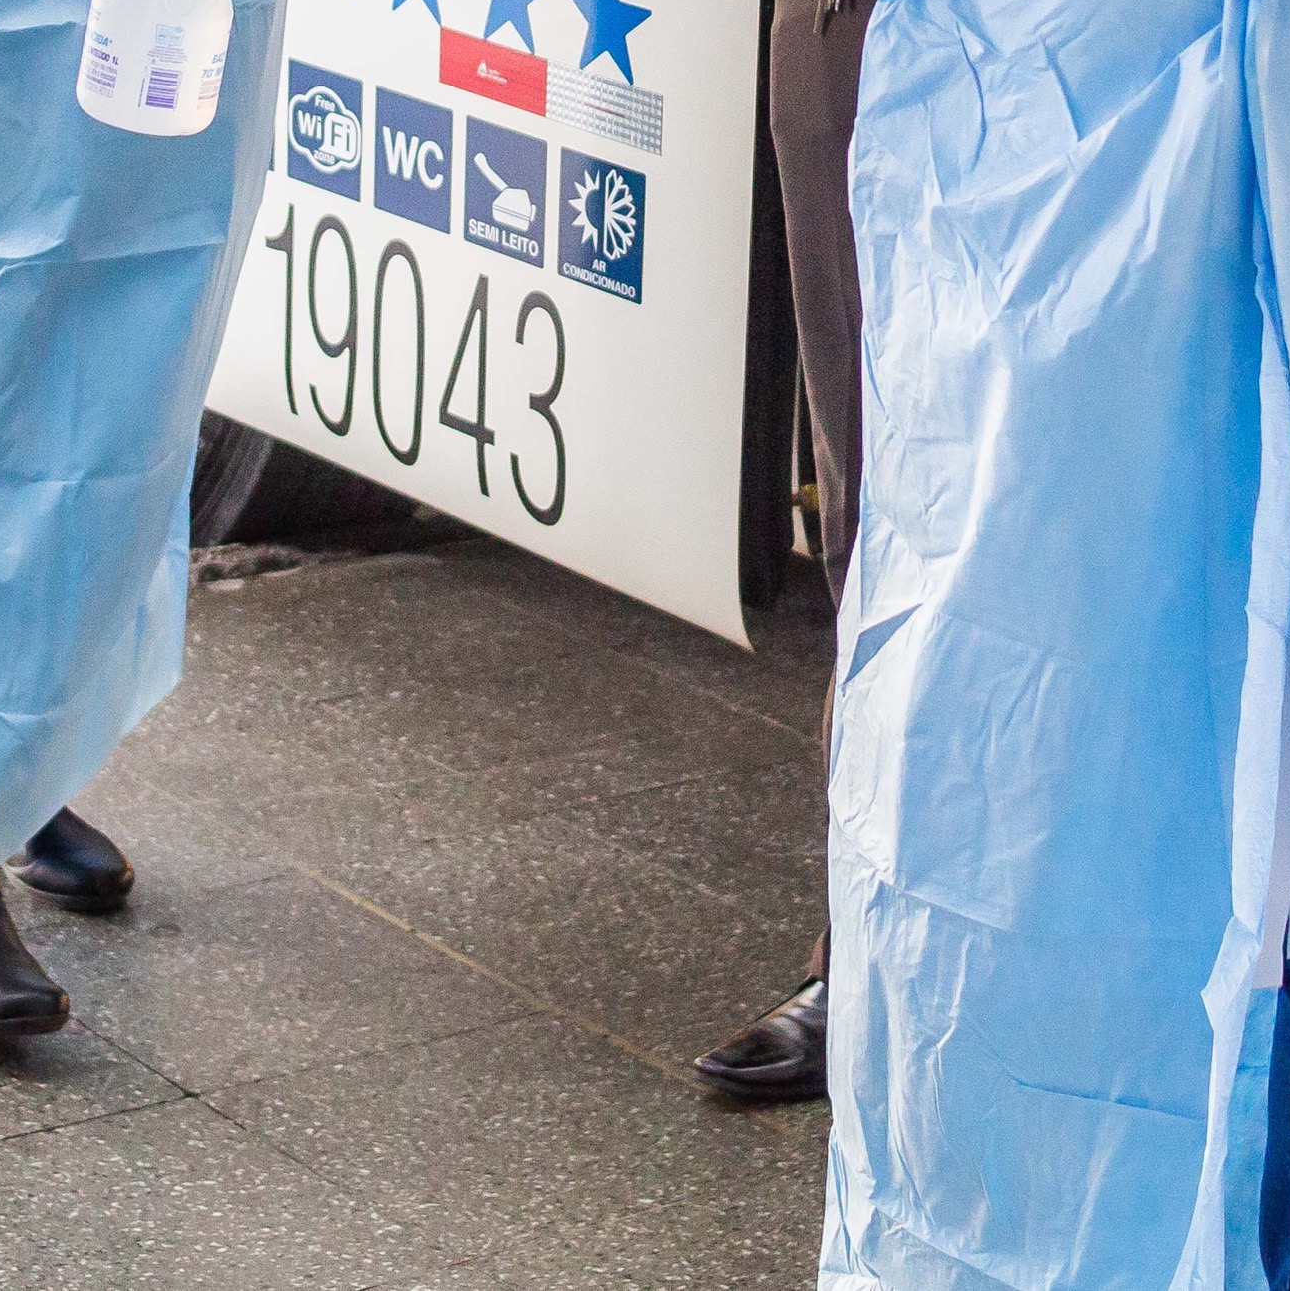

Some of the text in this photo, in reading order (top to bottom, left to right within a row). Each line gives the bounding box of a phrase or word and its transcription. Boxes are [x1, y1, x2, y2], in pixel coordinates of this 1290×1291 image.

[314, 95, 336, 112] Free
[314, 149, 336, 165] zone
[382, 125, 444, 191] WC
[469, 218, 539, 258] SEMI LEITO
[562, 261, 636, 298] CONDICIONADO
[592, 259, 607, 273] AR
[265, 202, 567, 527] 19043
